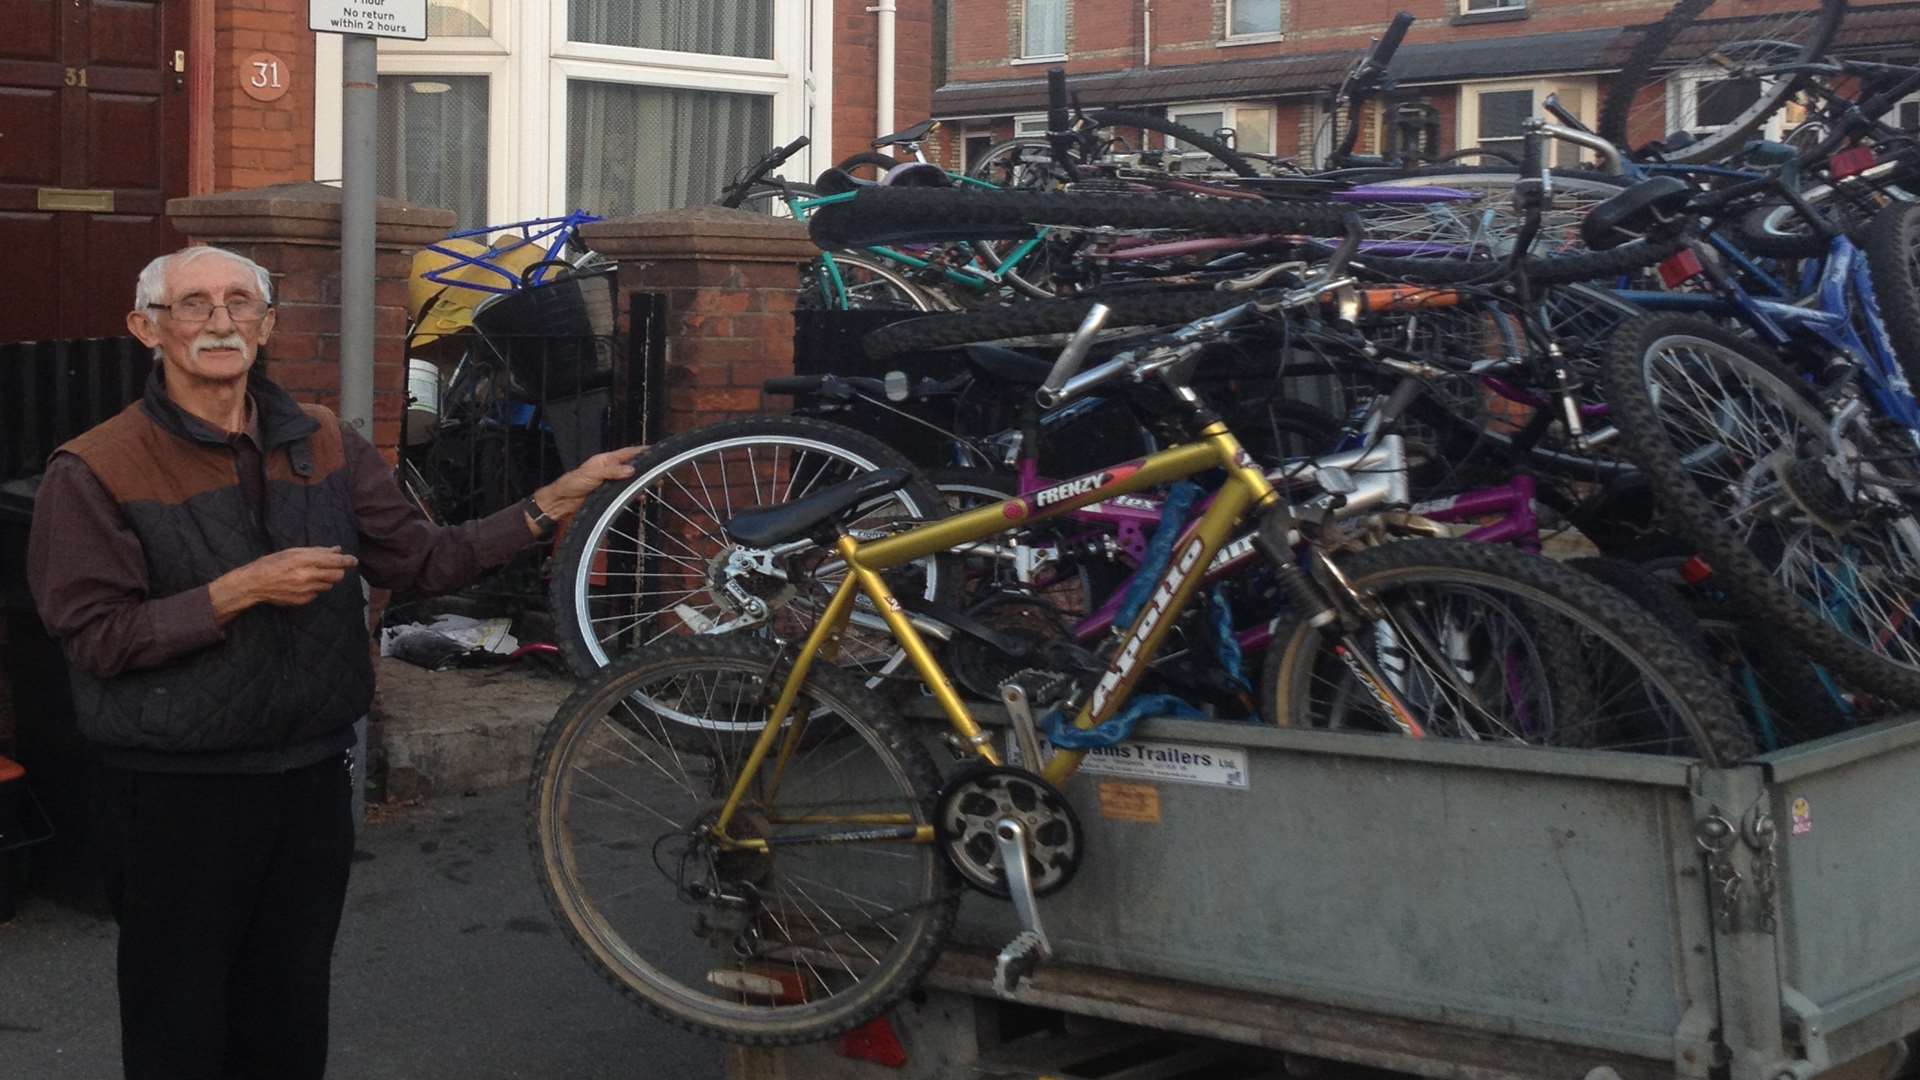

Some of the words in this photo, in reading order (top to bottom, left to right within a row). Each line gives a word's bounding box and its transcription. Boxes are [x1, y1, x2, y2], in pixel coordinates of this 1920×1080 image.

[331, 18, 364, 29] within
[367, 21, 374, 30] 2
[377, 23, 407, 33] hours
[343, 7, 359, 18] No
[362, 10, 395, 21] return
[65, 67, 88, 88] 31
[251, 61, 281, 88] 31
[1037, 472, 1106, 508] FRENZY
[1092, 538, 1203, 718] Apollo
[1134, 744, 1212, 767] Trailers
